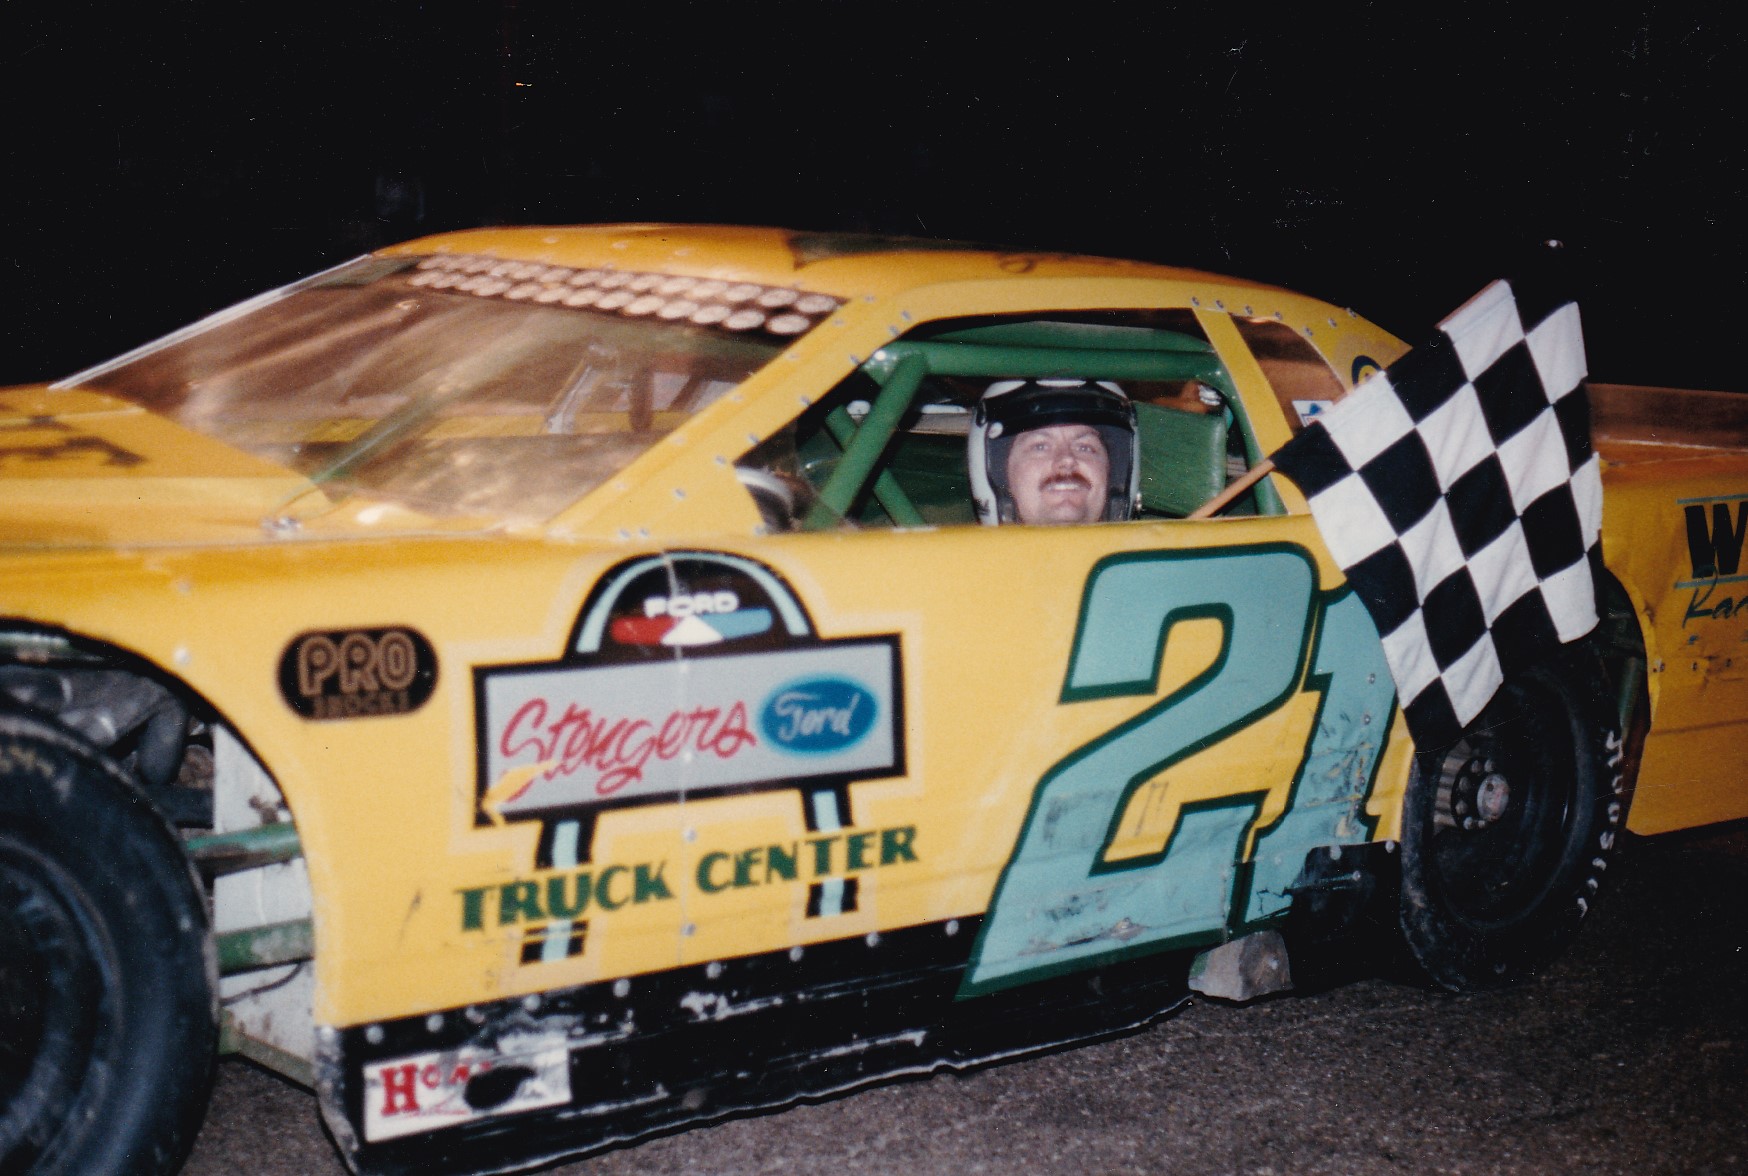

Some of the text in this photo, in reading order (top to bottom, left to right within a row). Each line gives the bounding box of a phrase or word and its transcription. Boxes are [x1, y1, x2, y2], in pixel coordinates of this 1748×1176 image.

[643, 590, 739, 619] FORD
[297, 632, 417, 696] PRO
[775, 692, 861, 742] Ford
[955, 541, 1397, 1000] 21
[455, 825, 918, 932] TRUCK CENTER
